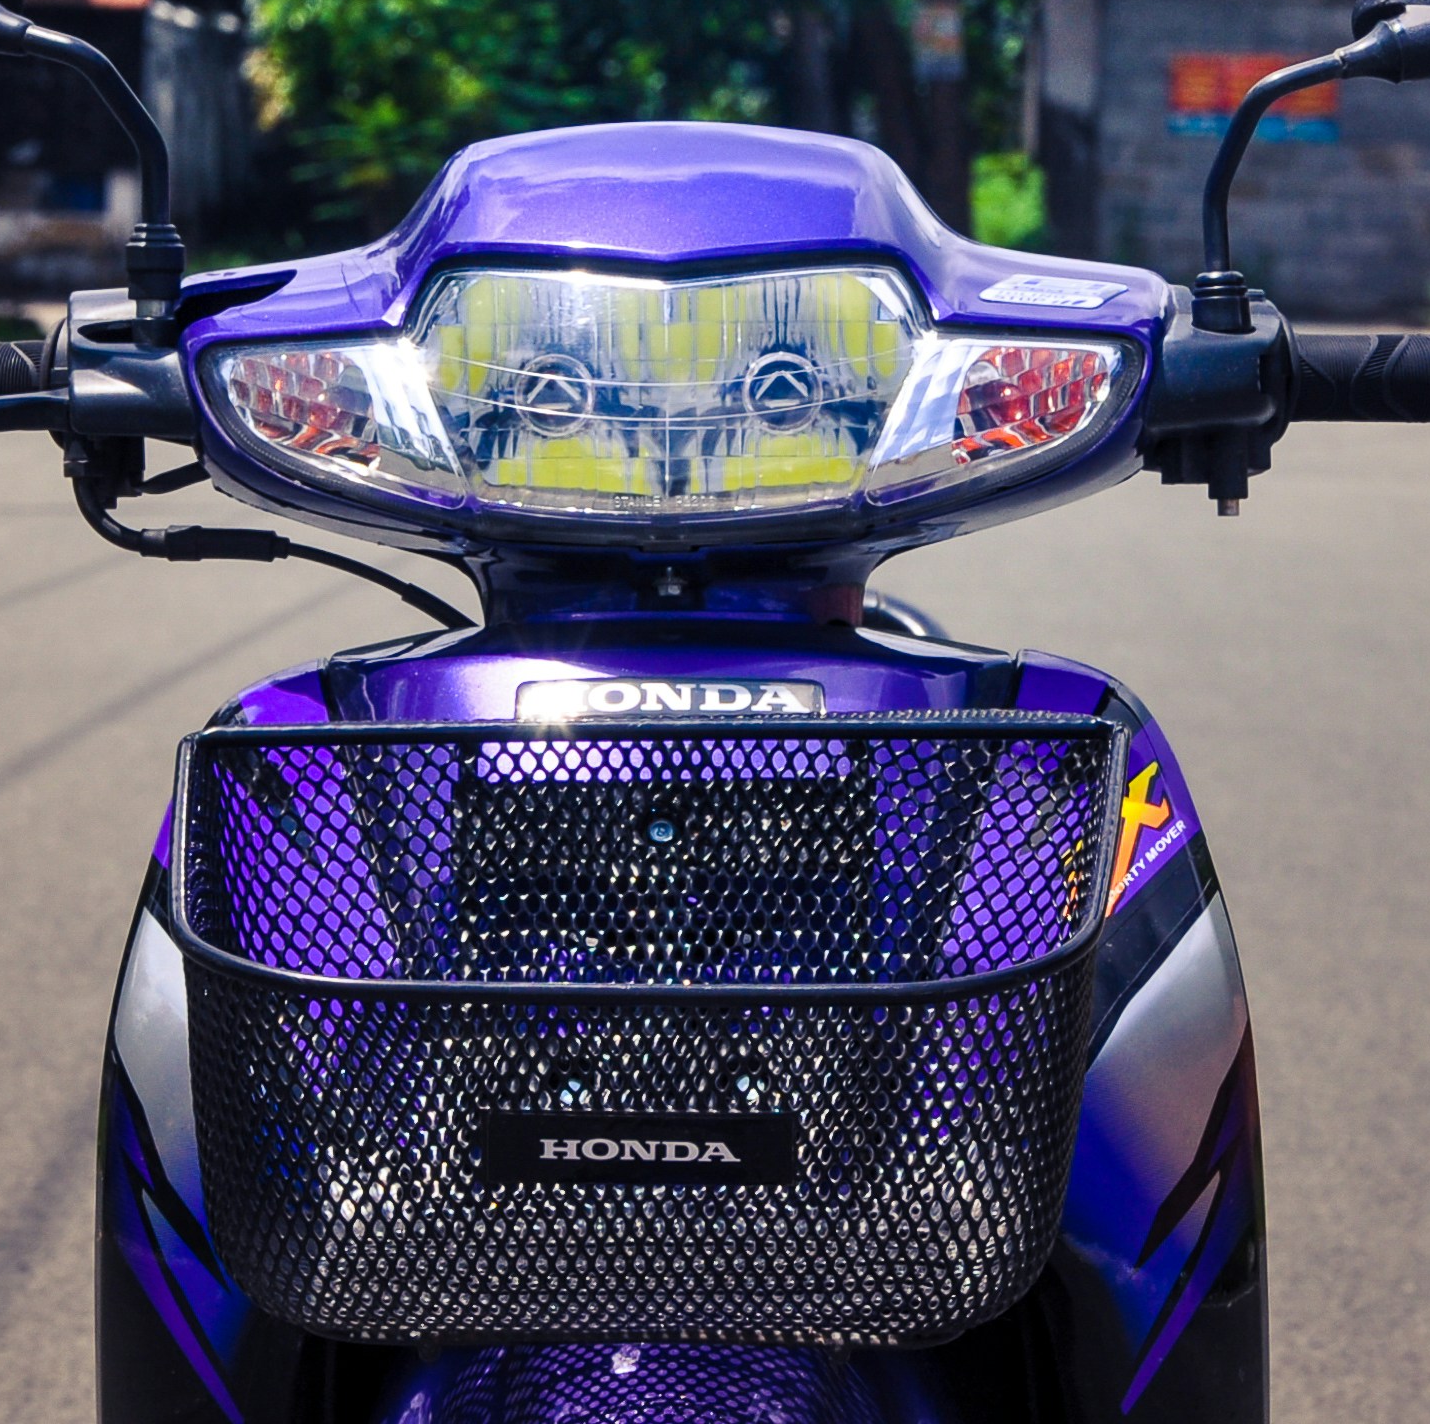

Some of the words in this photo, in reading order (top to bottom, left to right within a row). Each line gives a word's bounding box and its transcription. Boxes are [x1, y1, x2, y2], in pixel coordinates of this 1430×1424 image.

[533, 682, 811, 714] ONDA
[1107, 858, 1147, 904] PORTY
[1144, 819, 1187, 862] MOVER
[539, 1138, 741, 1162] HONDA
